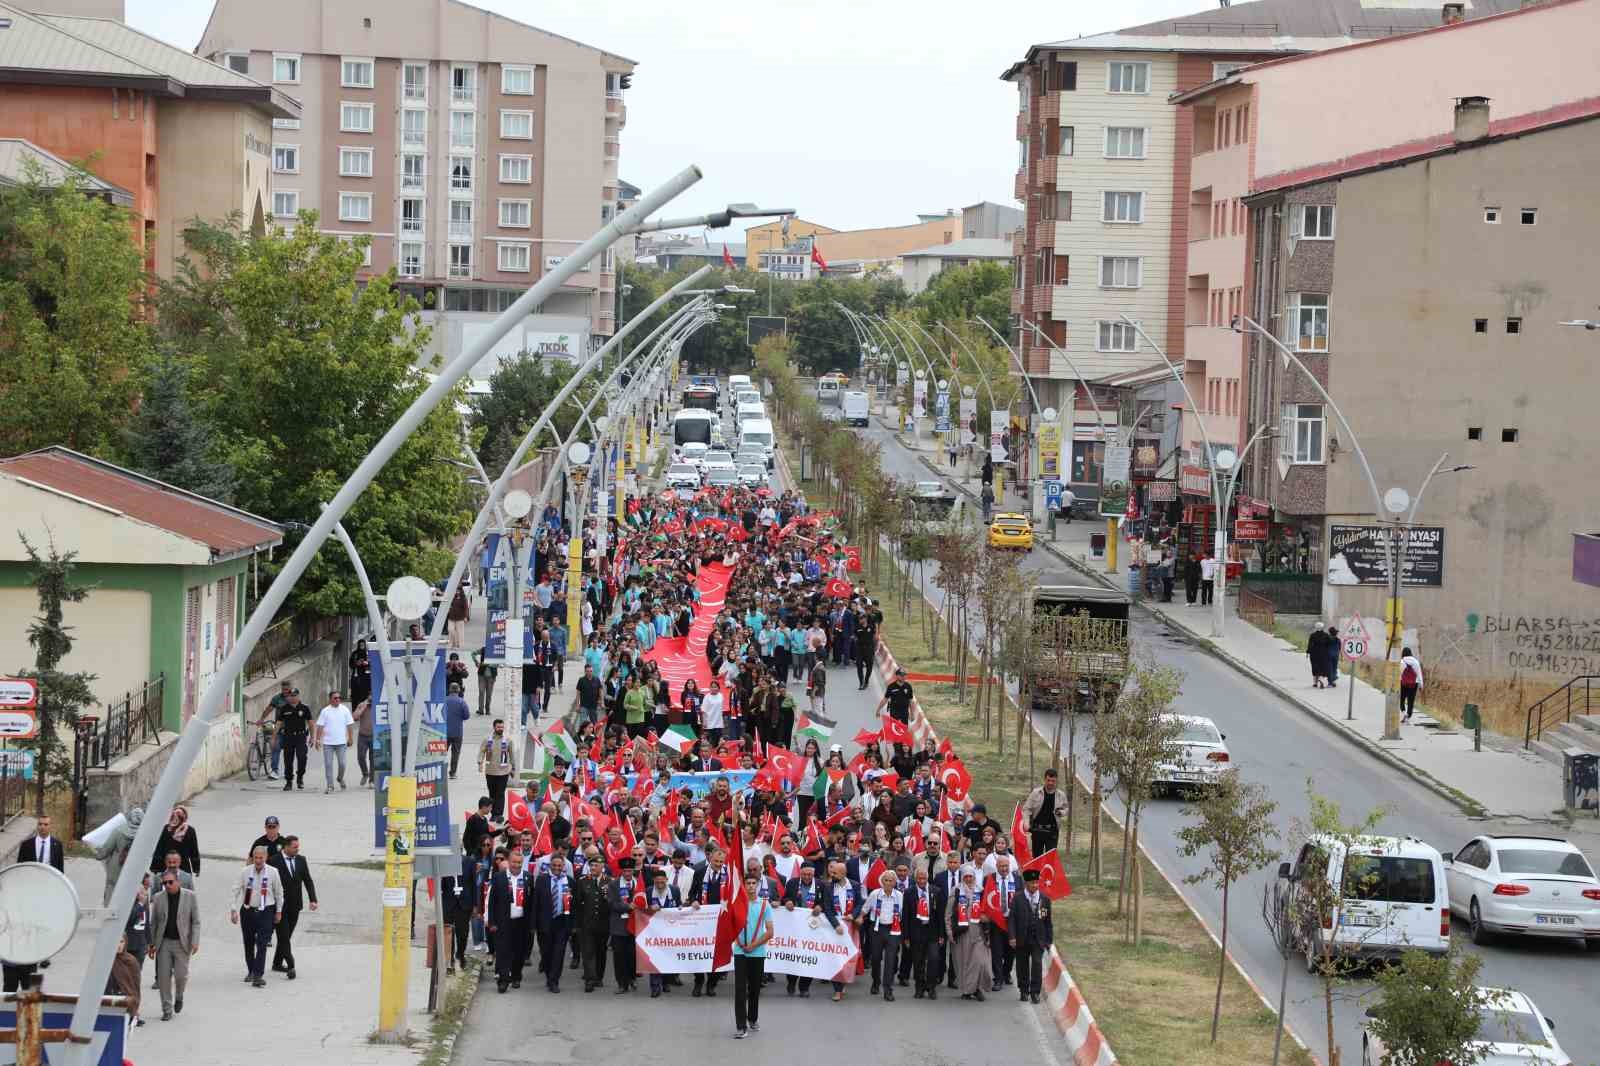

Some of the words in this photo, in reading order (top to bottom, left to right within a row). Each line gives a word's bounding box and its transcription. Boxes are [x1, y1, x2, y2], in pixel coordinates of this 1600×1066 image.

[539, 342, 568, 353] TKDK
[1346, 641, 1363, 654] 30
[801, 939, 849, 956] YOLUNDA
[676, 952, 686, 961] 19
[774, 951, 818, 966] YÜRÜYÜŞÜ
